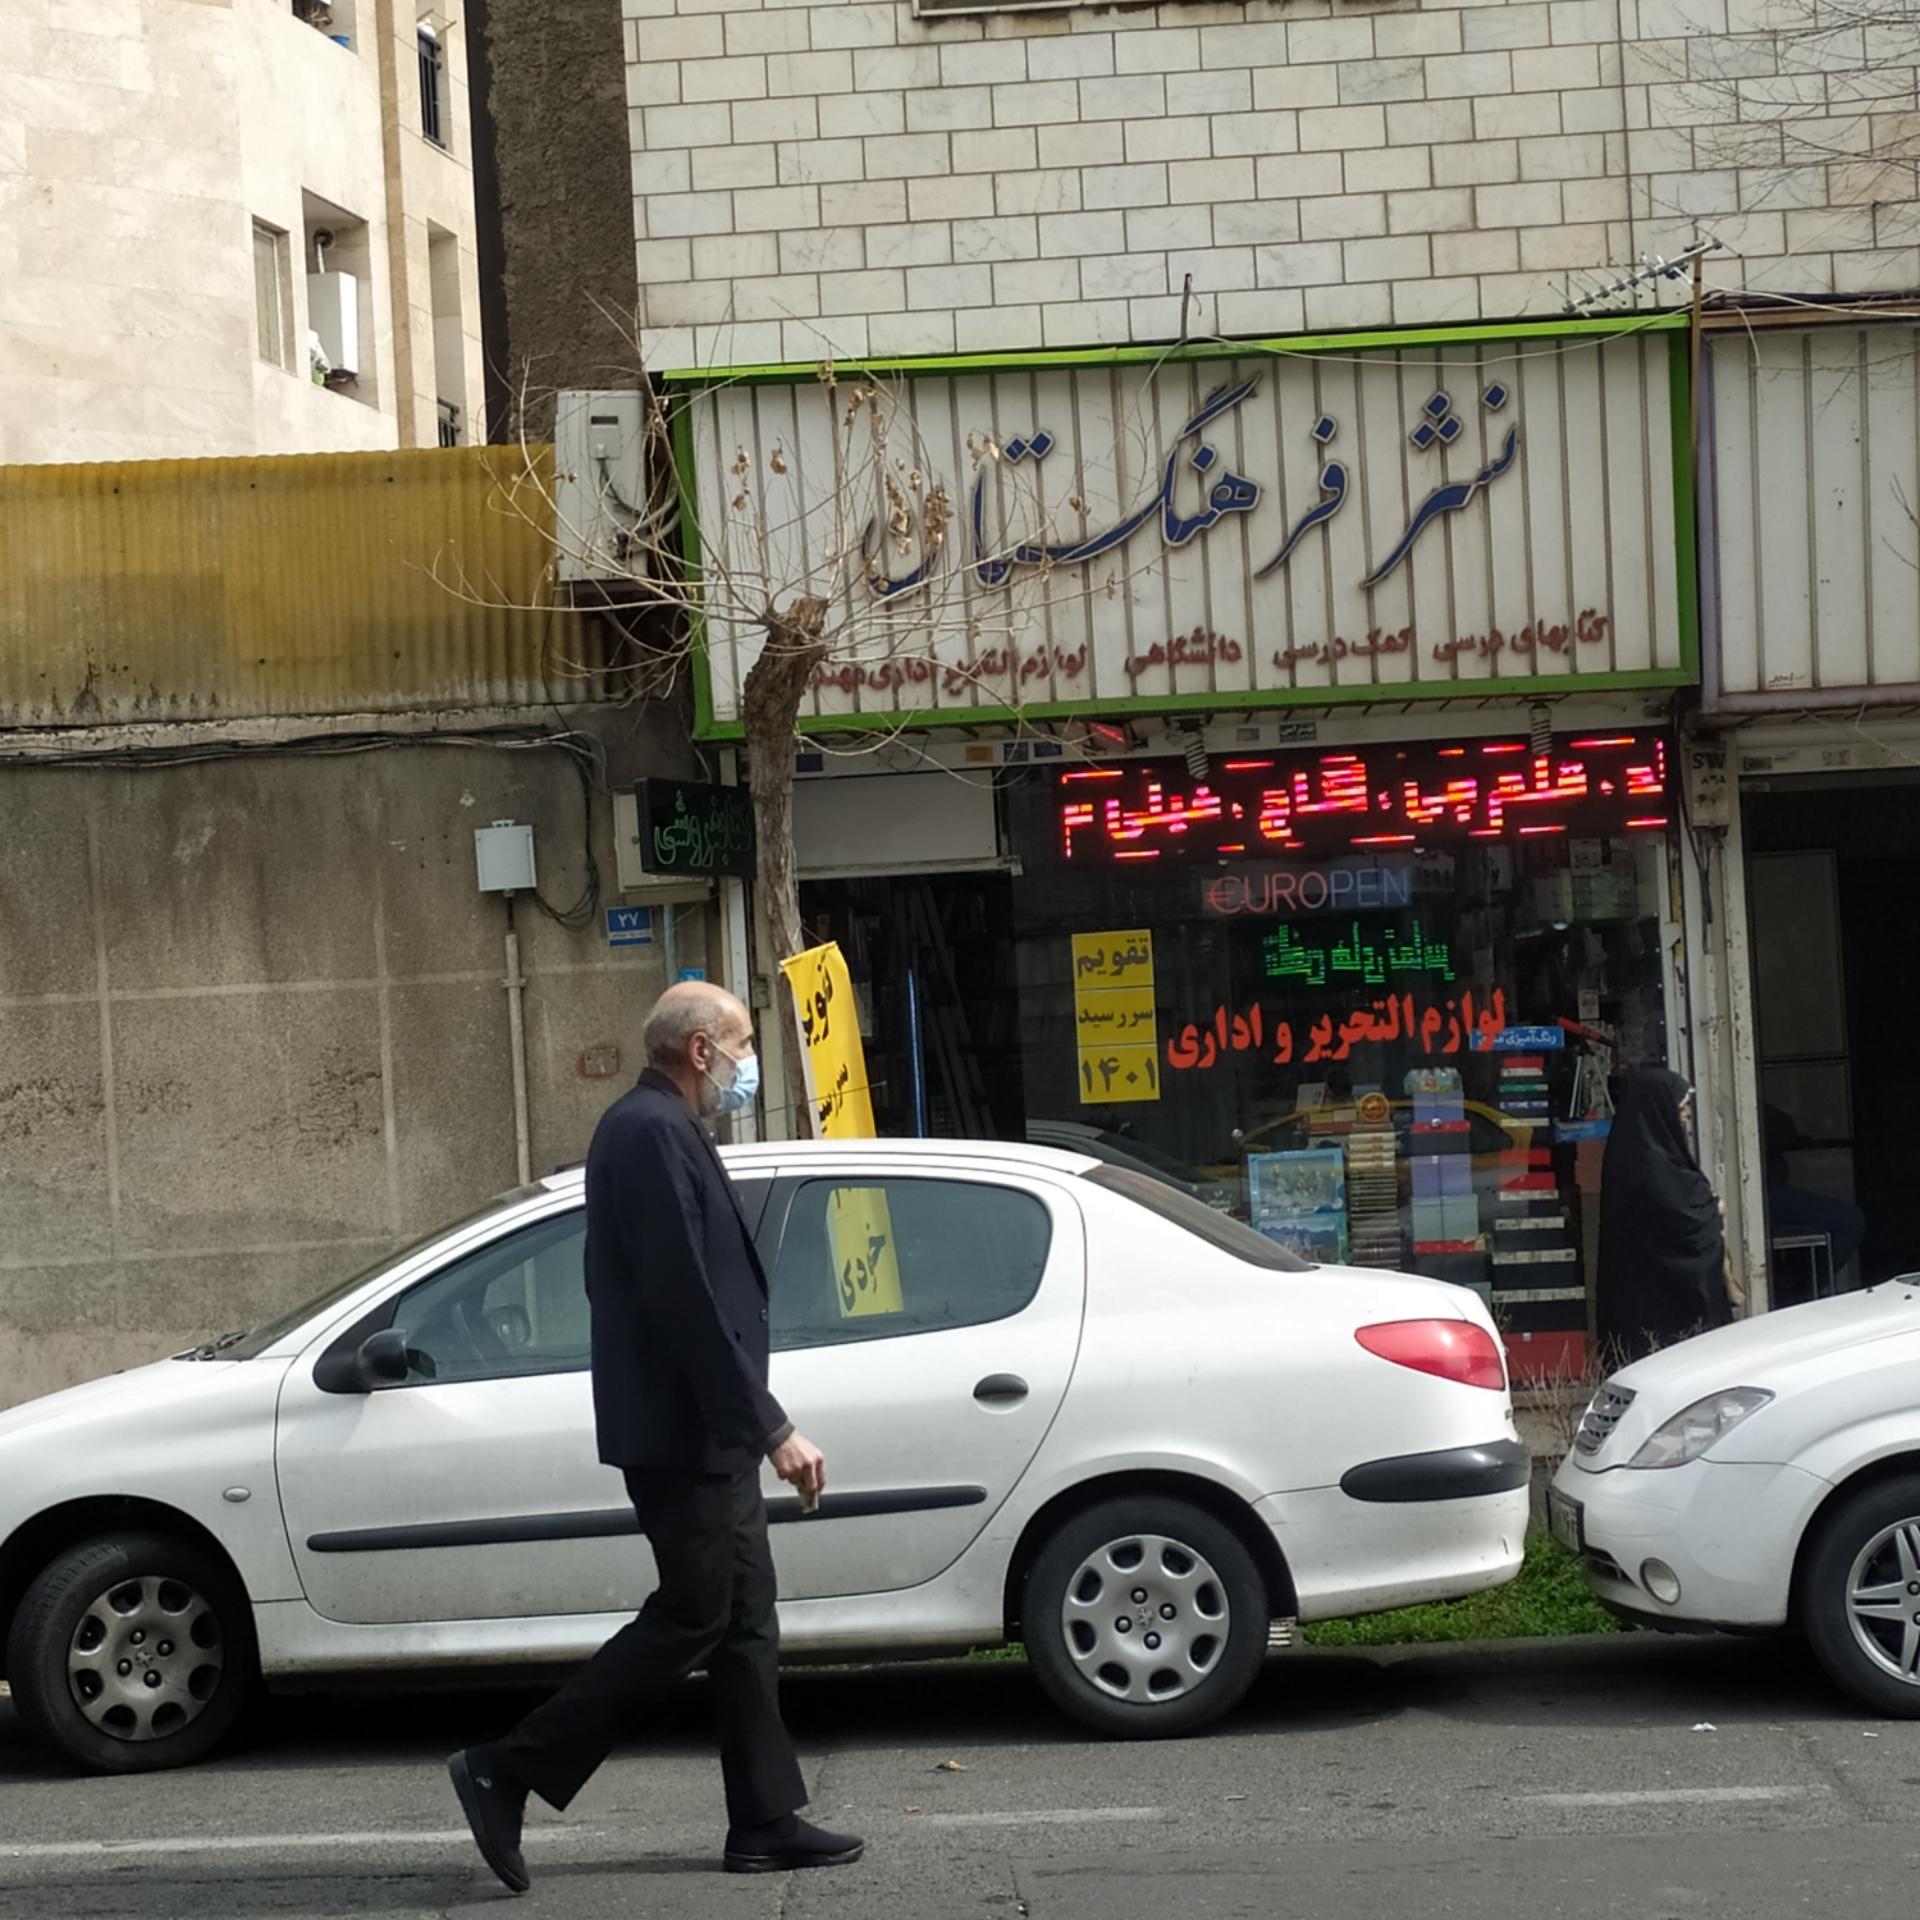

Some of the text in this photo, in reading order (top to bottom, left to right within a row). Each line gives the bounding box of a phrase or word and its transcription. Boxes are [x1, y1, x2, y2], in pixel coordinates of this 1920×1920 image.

[862, 370, 1518, 600] نشر فرهنگستان
[1124, 627, 1242, 675] دانشگاهی
[1351, 626, 1412, 656] کمک
[1432, 628, 1505, 662] درسی
[1510, 607, 1608, 657] کتابهای
[1020, 643, 1087, 686] لوازم
[1272, 637, 1348, 669] درسی
[617, 911, 639, 928] ۲۷
[1076, 938, 1150, 977] تقویم
[1167, 987, 1506, 1069] لوازم التحریر و اداری
[1081, 1056, 1156, 1093] ۱۴۰۱
